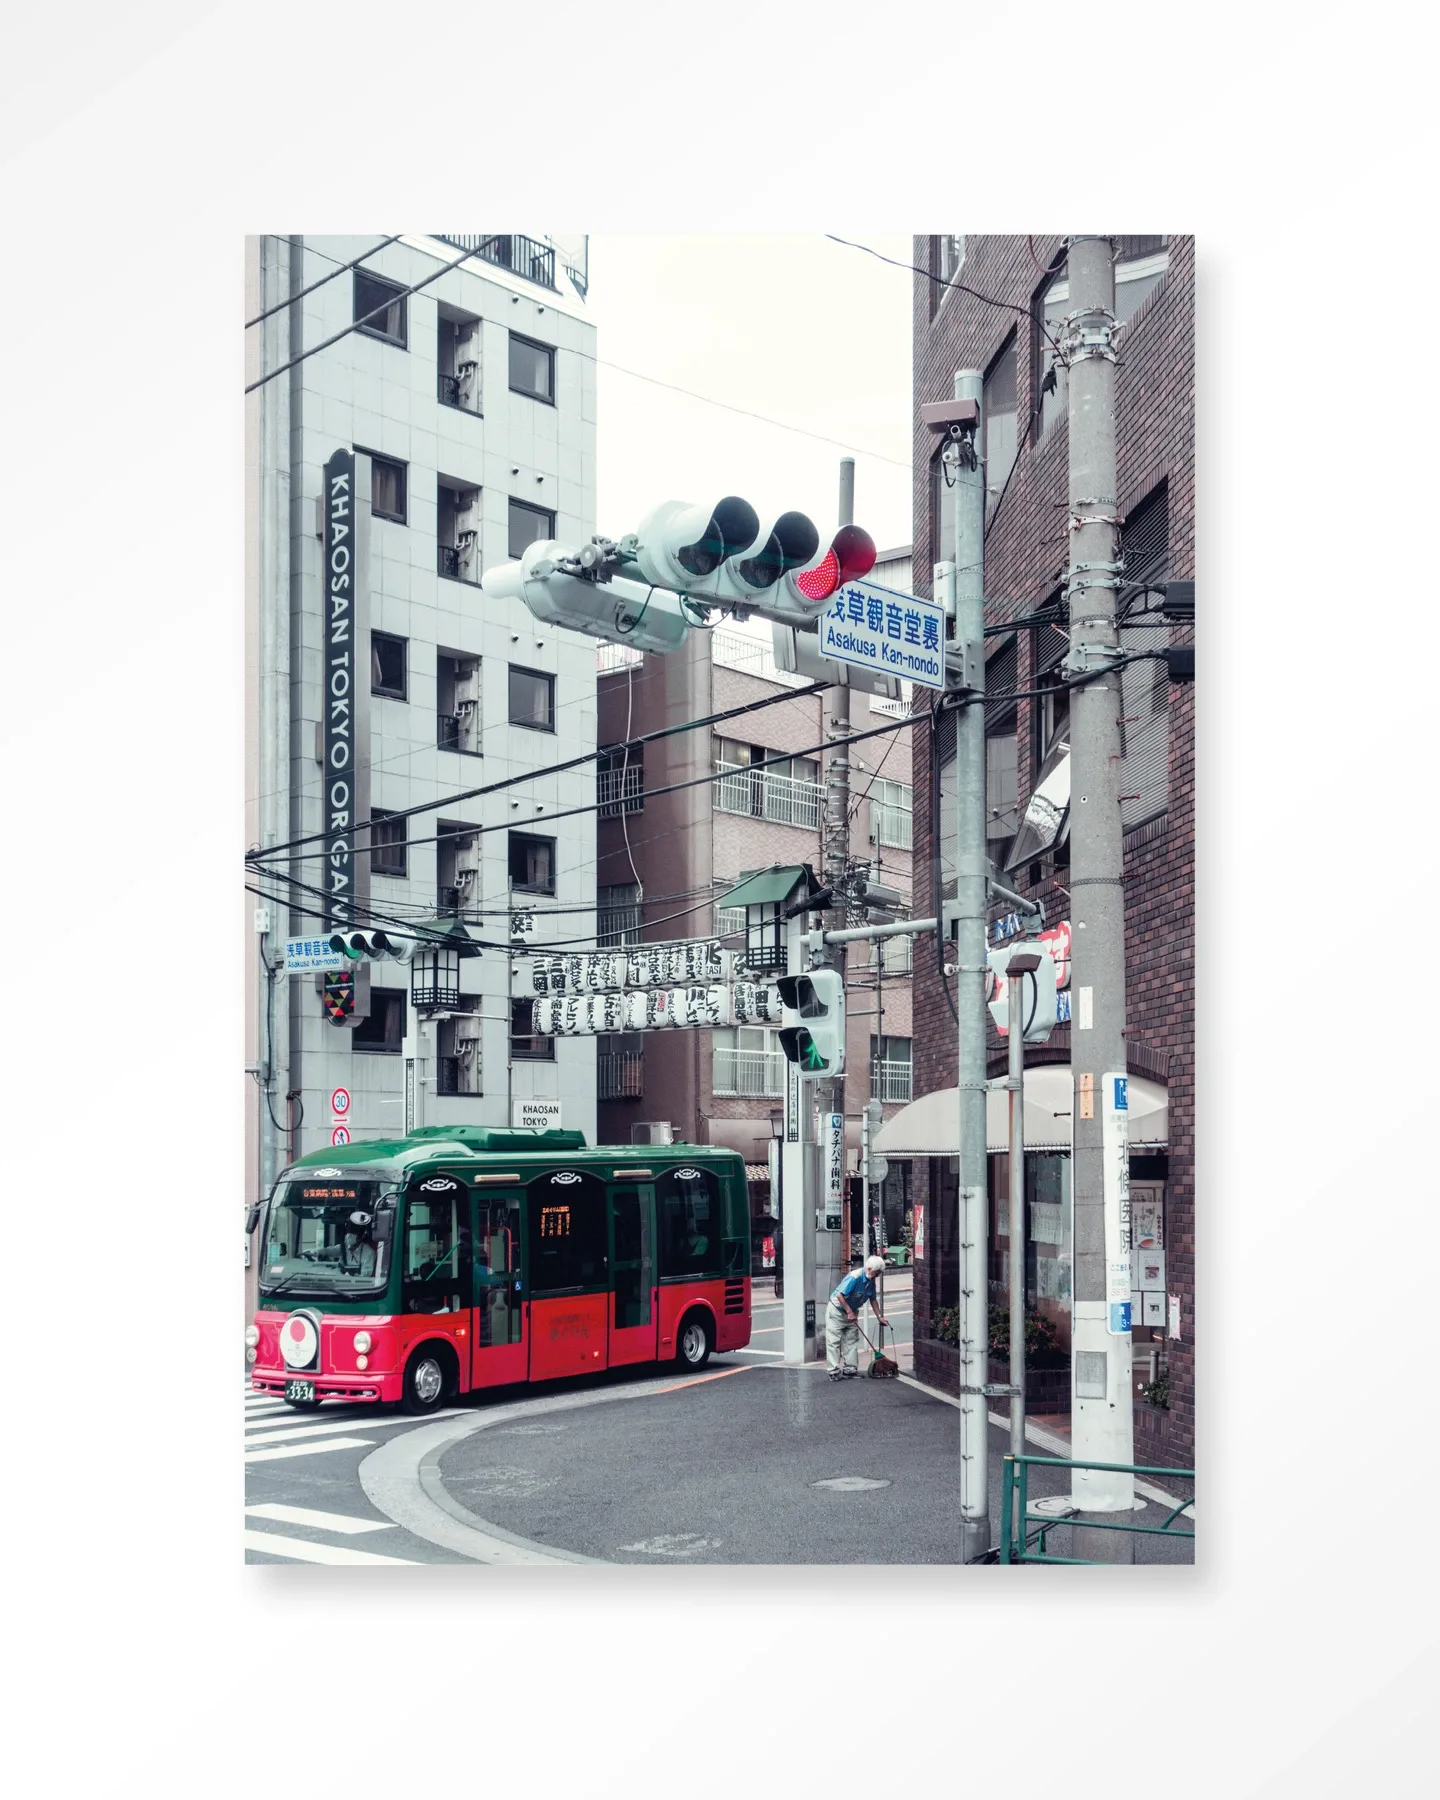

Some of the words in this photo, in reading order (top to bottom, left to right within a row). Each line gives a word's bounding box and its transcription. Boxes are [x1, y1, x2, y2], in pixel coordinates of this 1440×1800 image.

[331, 473, 349, 644] KHAOSAN
[827, 626, 876, 658] Asakusa
[881, 642, 939, 676] Kan-nondo
[331, 651, 349, 769] TOKYO
[287, 940, 339, 957] 浅草観音堂
[335, 1095, 346, 1108] 30
[522, 1105, 559, 1115] KHAOSAN
[522, 1117, 548, 1127] TOKYO
